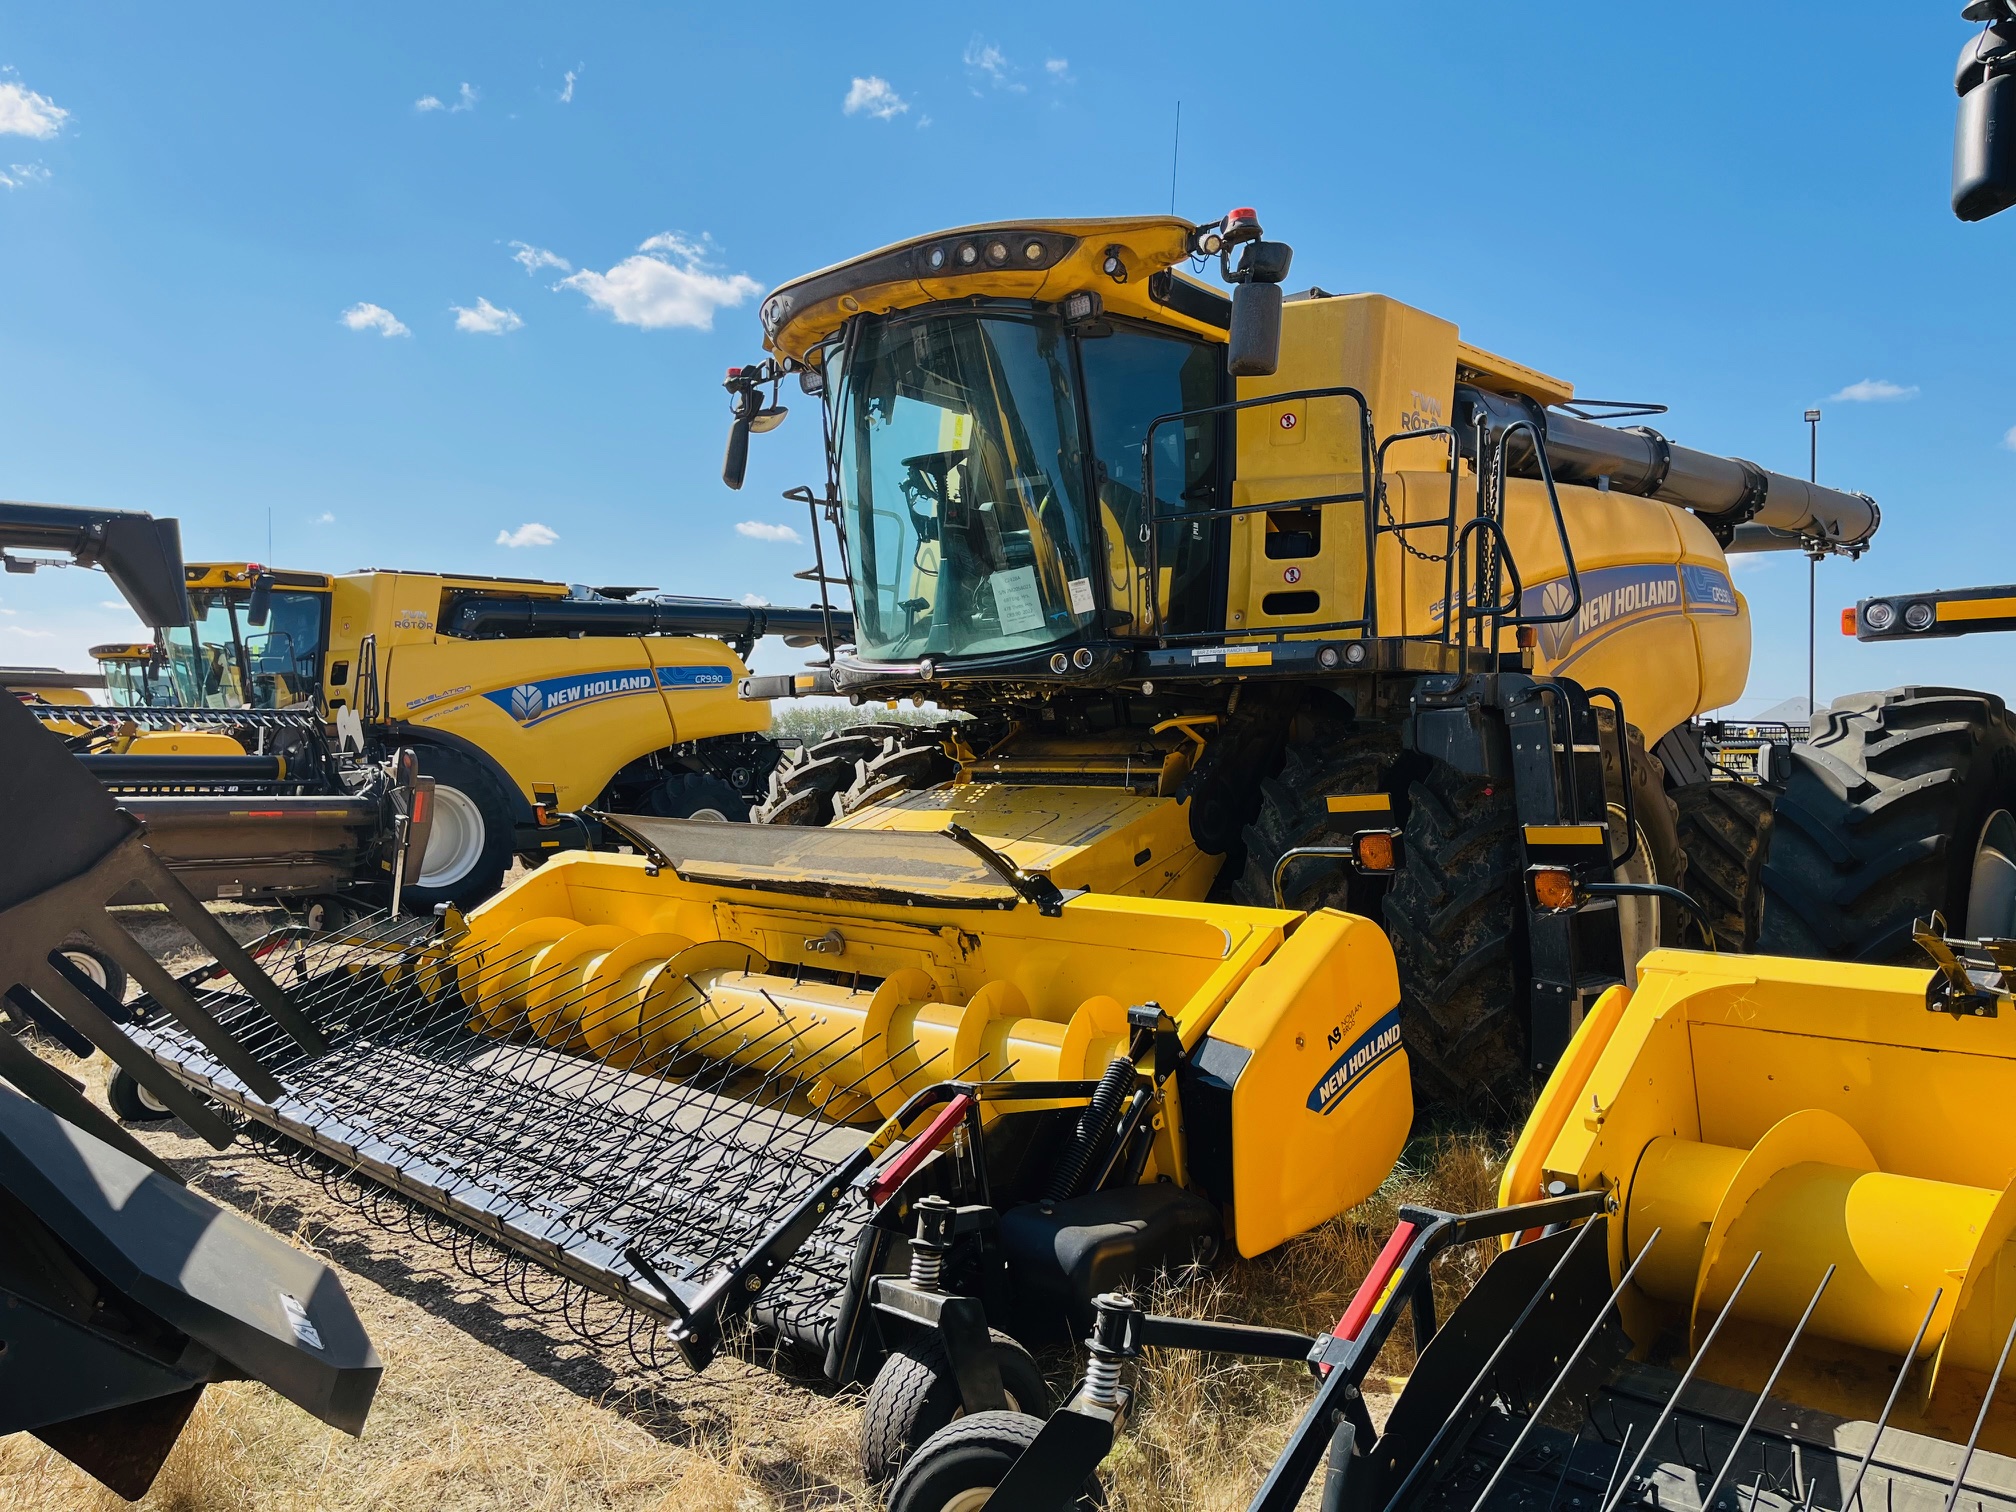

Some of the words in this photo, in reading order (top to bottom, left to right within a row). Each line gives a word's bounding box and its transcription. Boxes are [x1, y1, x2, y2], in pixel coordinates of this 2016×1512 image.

[1411, 390, 1441, 418] TWIN
[401, 610, 428, 619] TWIN
[1578, 591, 1612, 635] NEW
[1614, 580, 1677, 617] HOLLAND
[394, 619, 433, 630] ROTOR
[406, 685, 472, 708] REVELATION
[547, 687, 581, 708] NEW
[584, 676, 651, 698] HOLLAND
[695, 675, 723, 684] CR9.90
[422, 703, 470, 722] OPTI-CLEAN
[1319, 1063, 1348, 1104] NEW
[1348, 1023, 1401, 1076] HOLLAND
